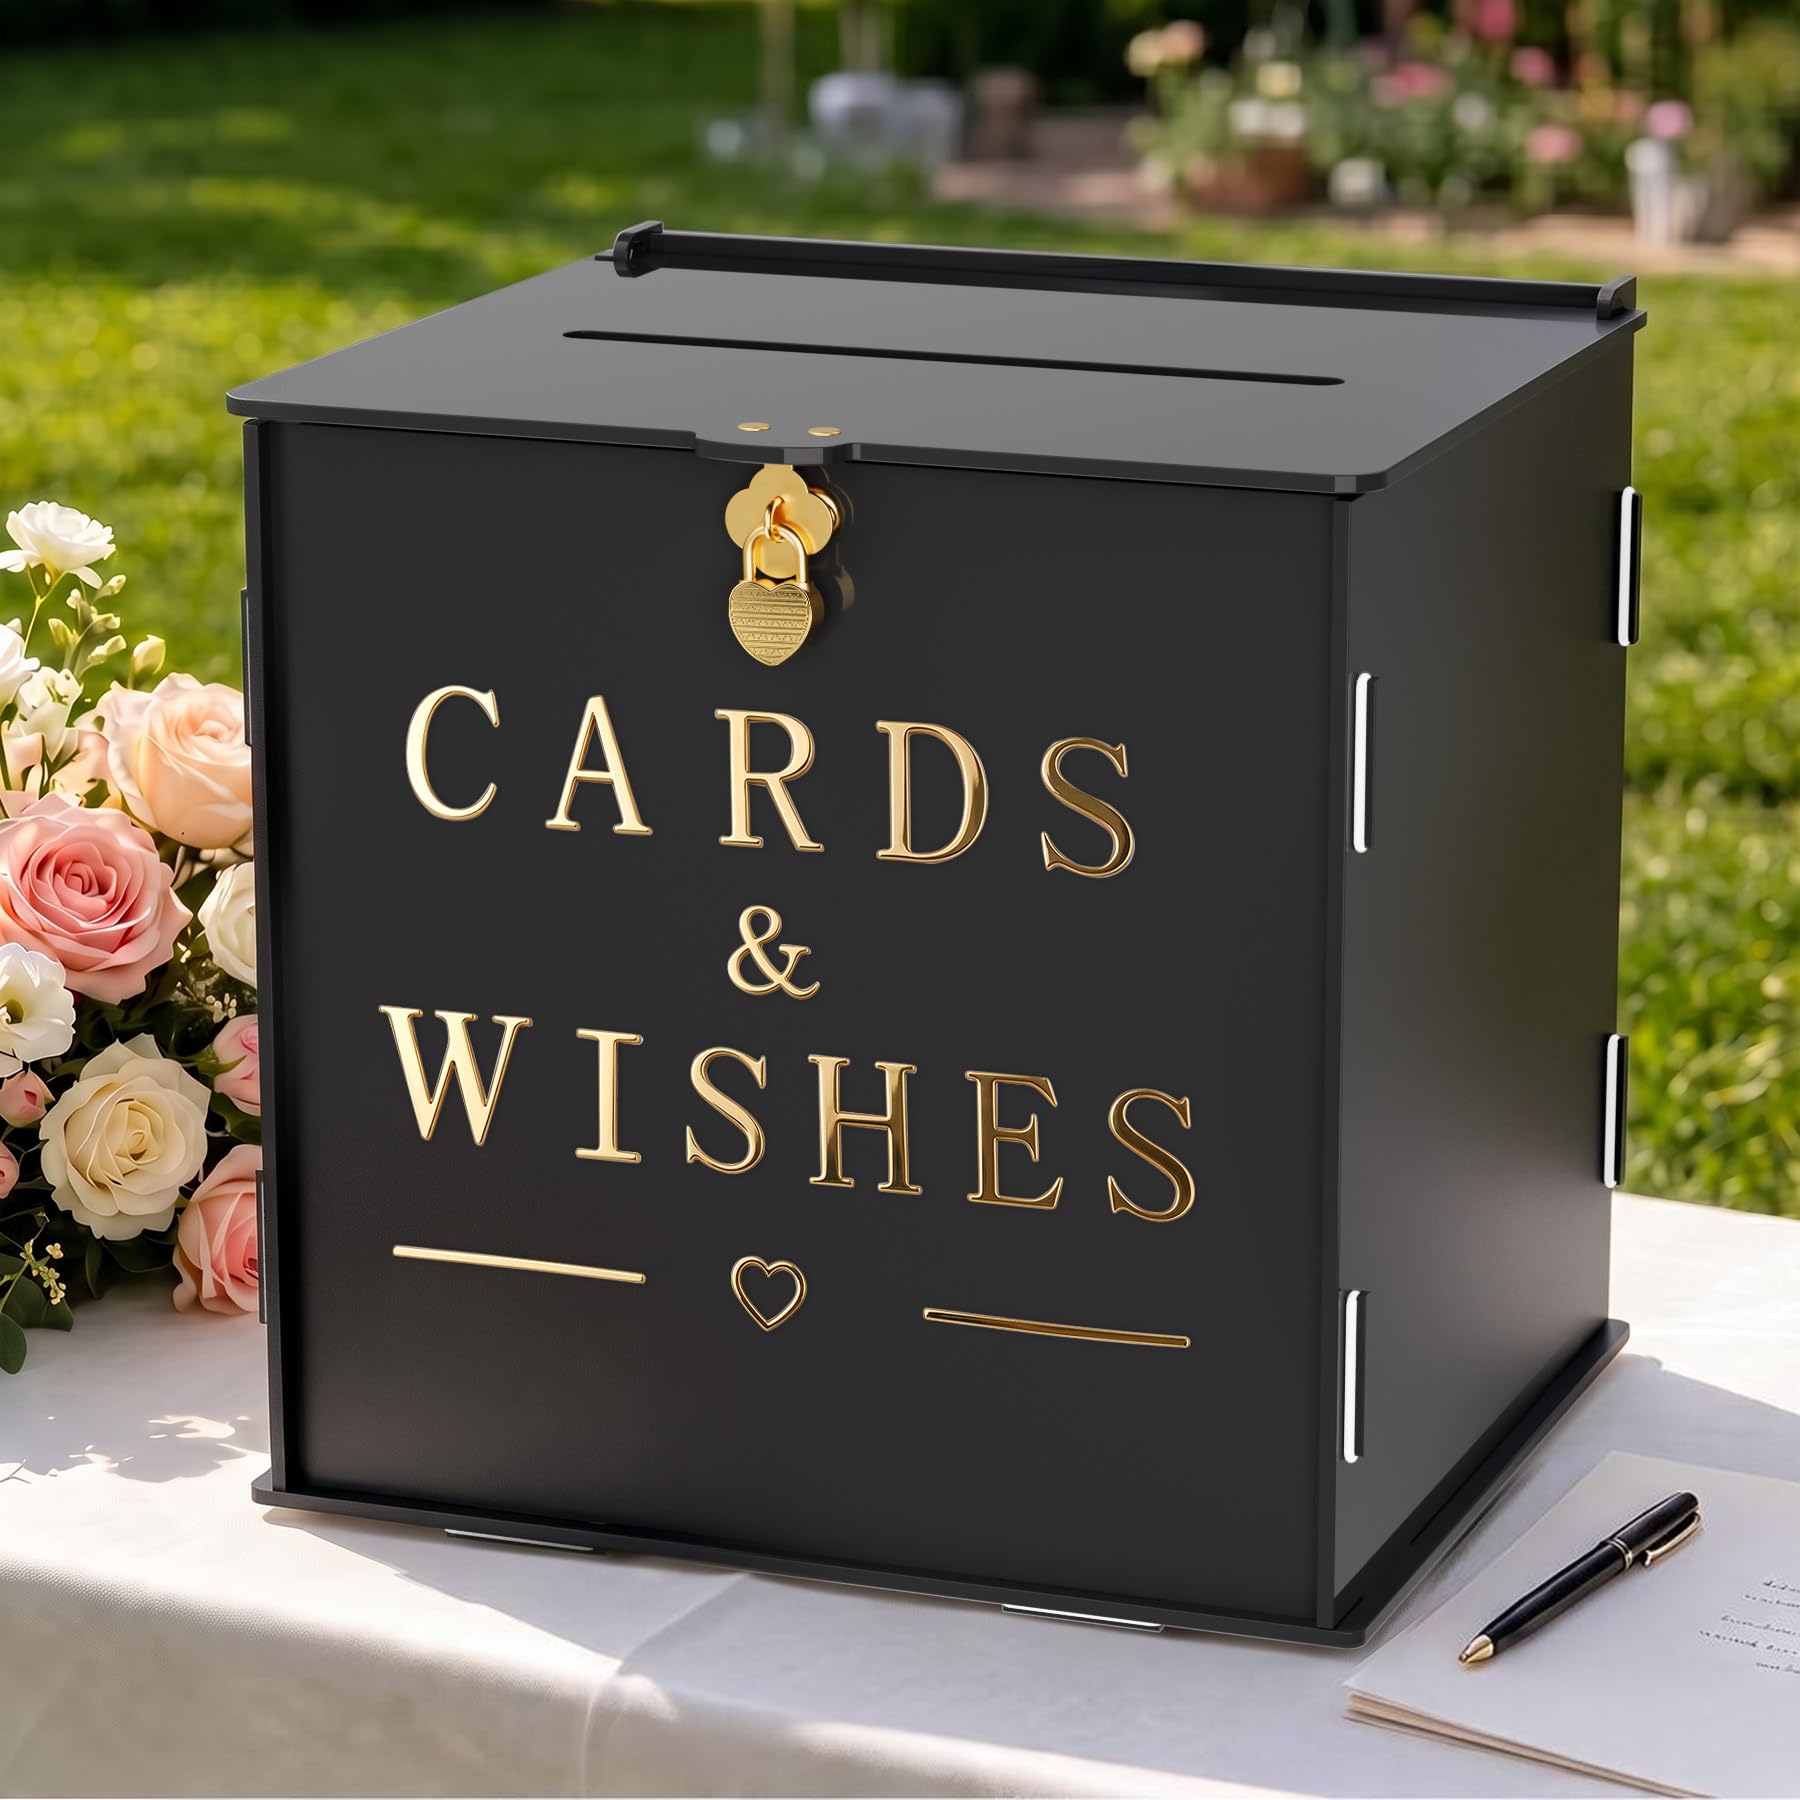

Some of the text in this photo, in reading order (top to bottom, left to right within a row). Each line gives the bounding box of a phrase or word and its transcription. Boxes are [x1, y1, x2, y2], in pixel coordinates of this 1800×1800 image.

[405, 685, 1136, 878] CARDS
[726, 904, 820, 1000] &
[378, 1004, 1196, 1222] WISHES
